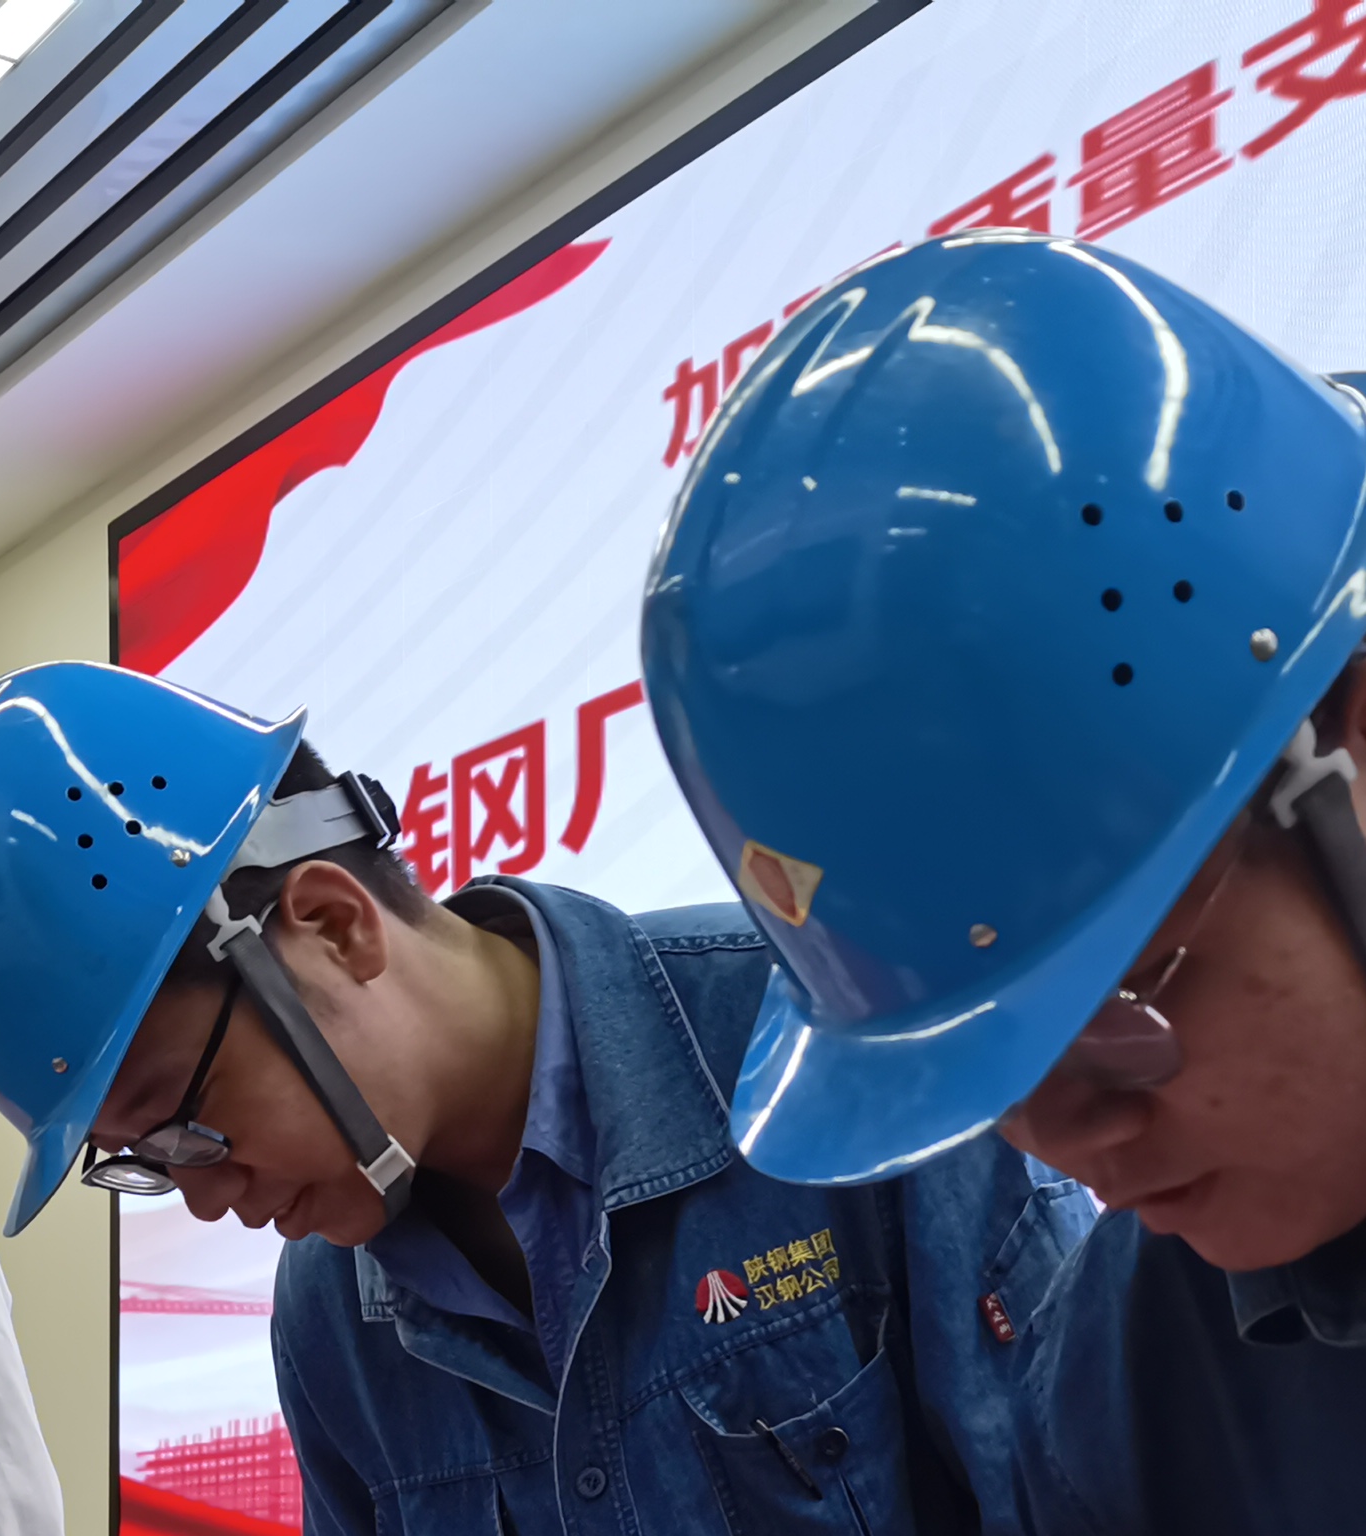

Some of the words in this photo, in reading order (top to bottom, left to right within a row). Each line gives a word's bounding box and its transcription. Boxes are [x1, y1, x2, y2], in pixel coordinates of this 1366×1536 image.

[742, 1228, 837, 1286] 陕钢集团
[752, 1256, 841, 1310] 汉钢公司
